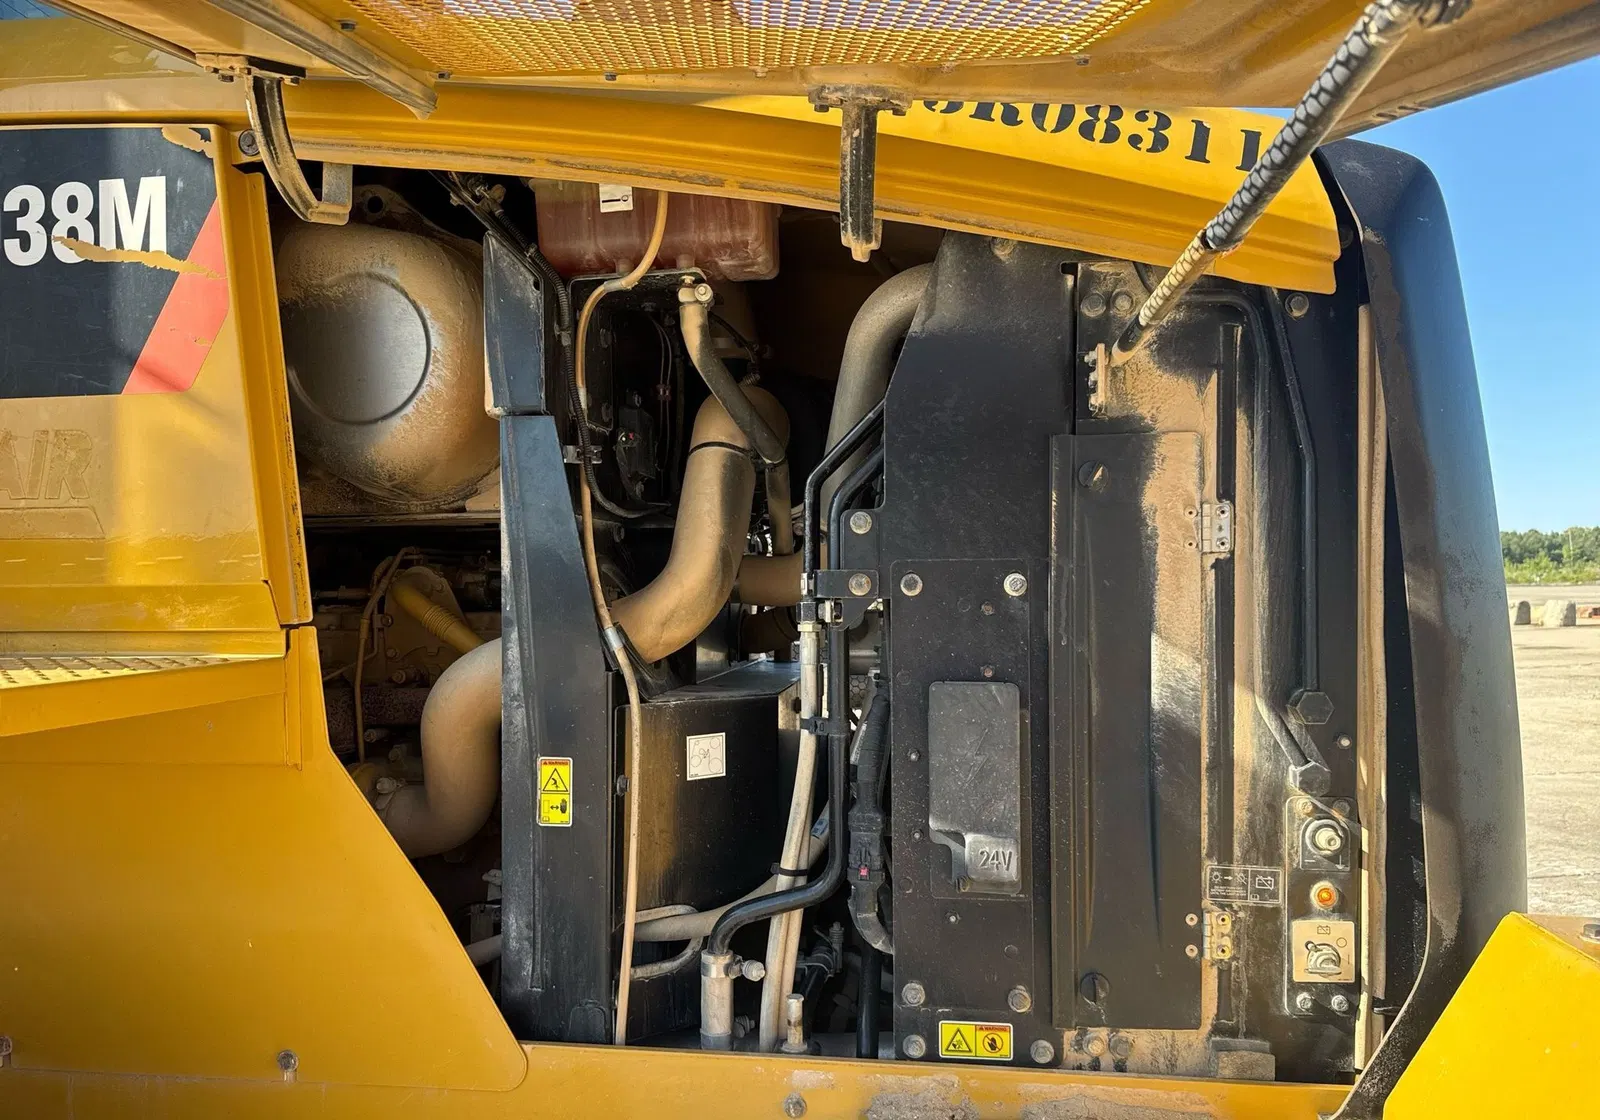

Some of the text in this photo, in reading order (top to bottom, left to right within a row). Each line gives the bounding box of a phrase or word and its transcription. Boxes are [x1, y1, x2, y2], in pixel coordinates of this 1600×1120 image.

[923, 100, 1262, 173] R08311
[3, 175, 167, 267] 38M
[979, 849, 1013, 871] 24V
